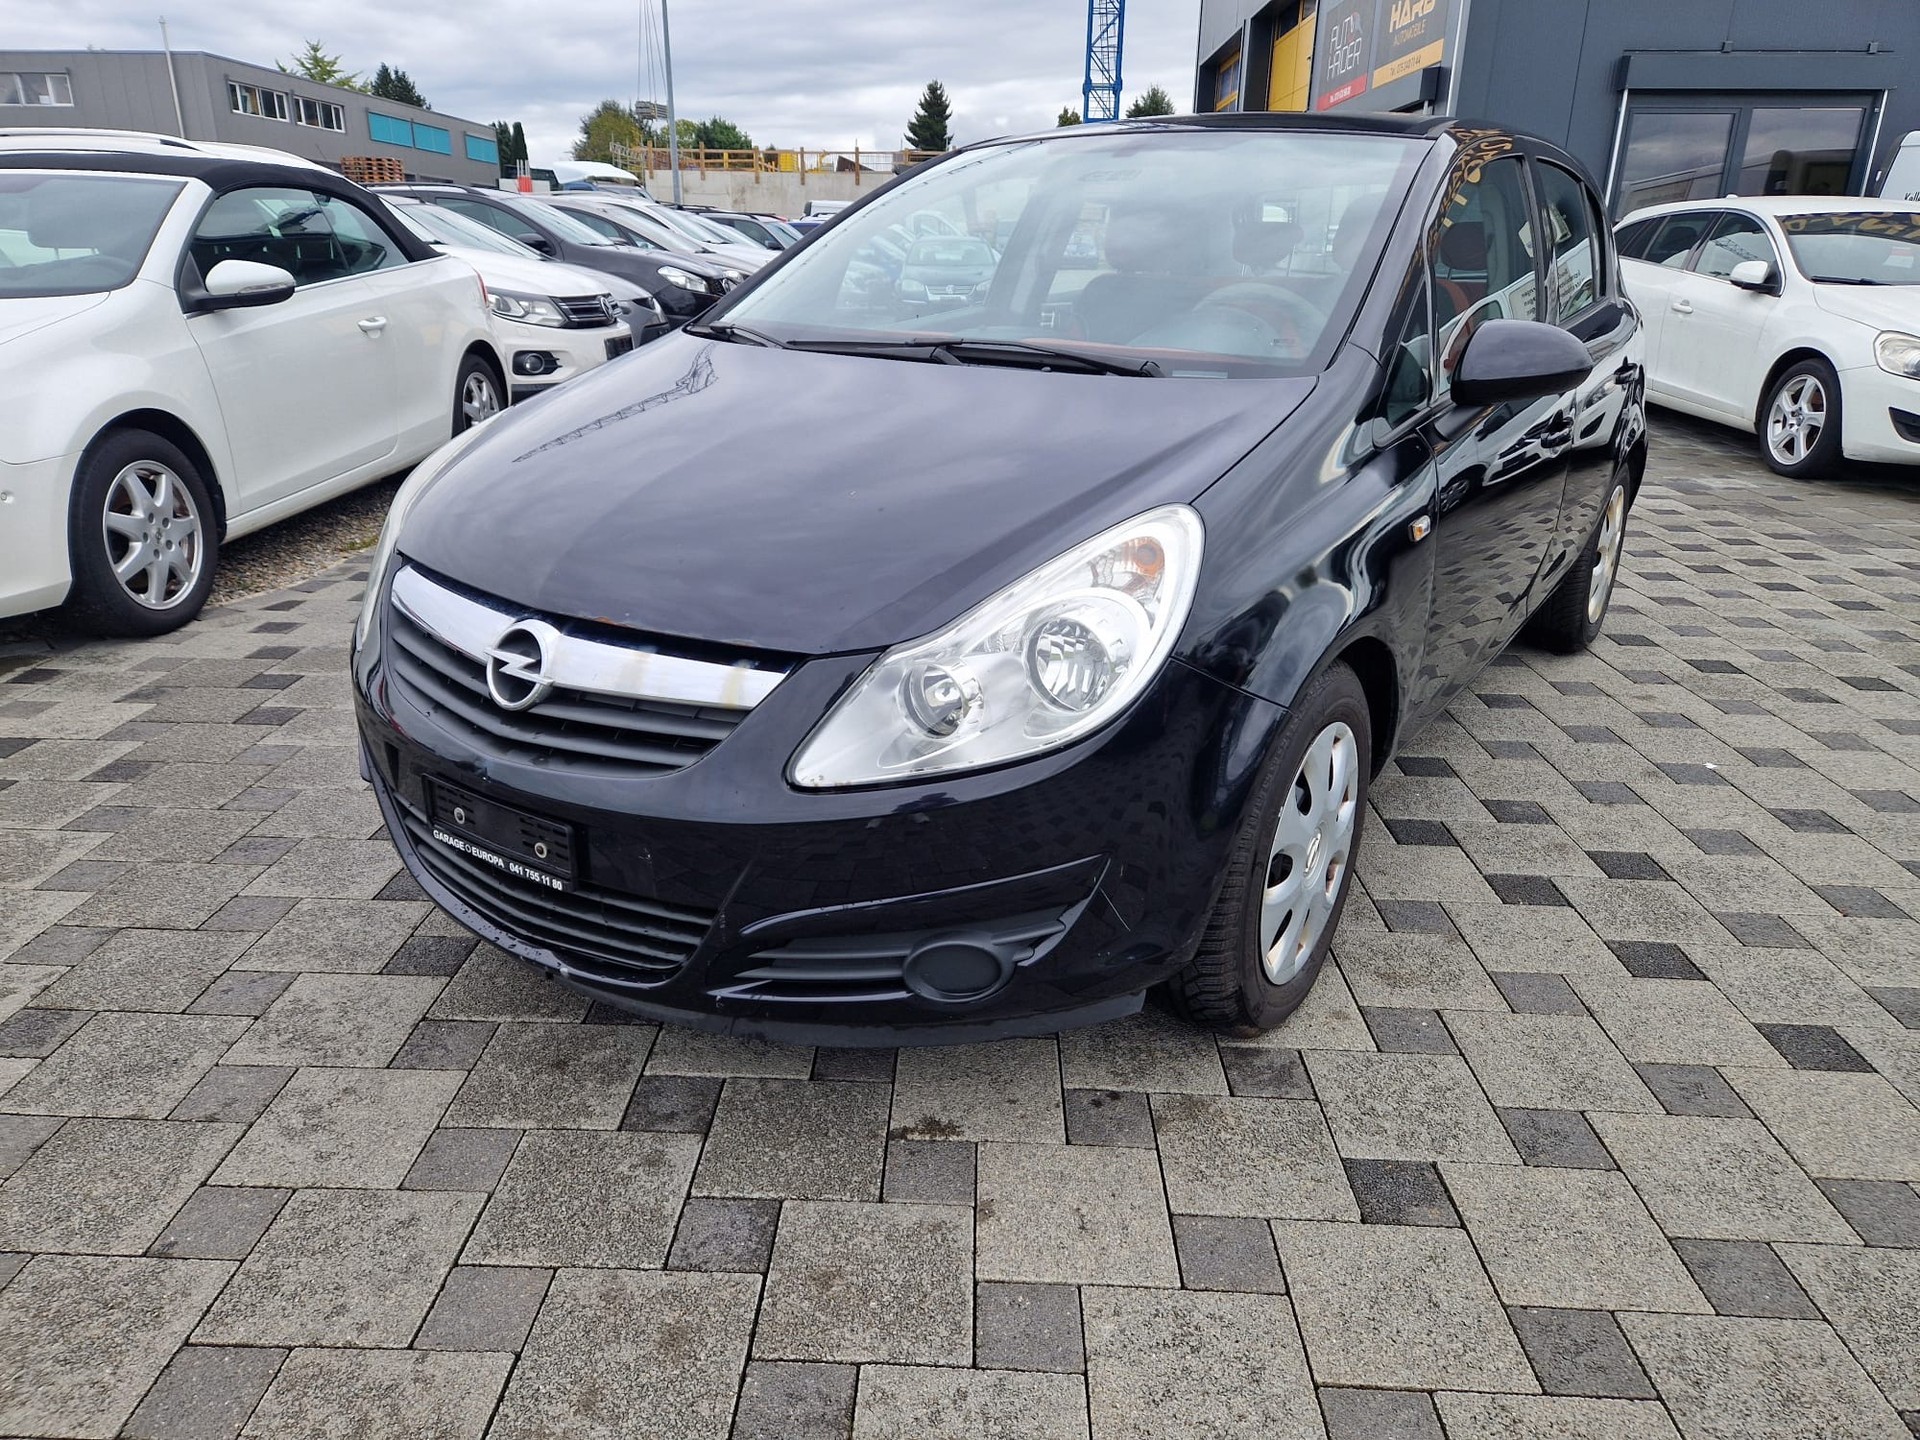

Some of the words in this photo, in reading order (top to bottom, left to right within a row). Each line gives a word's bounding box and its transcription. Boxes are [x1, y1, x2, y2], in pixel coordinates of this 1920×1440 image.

[433, 829, 465, 851] GARAGE
[471, 847, 505, 868] EUROPA
[509, 862, 523, 875] 041
[524, 868, 540, 882] 755
[541, 875, 550, 885] 11
[552, 879, 563, 890] 80
